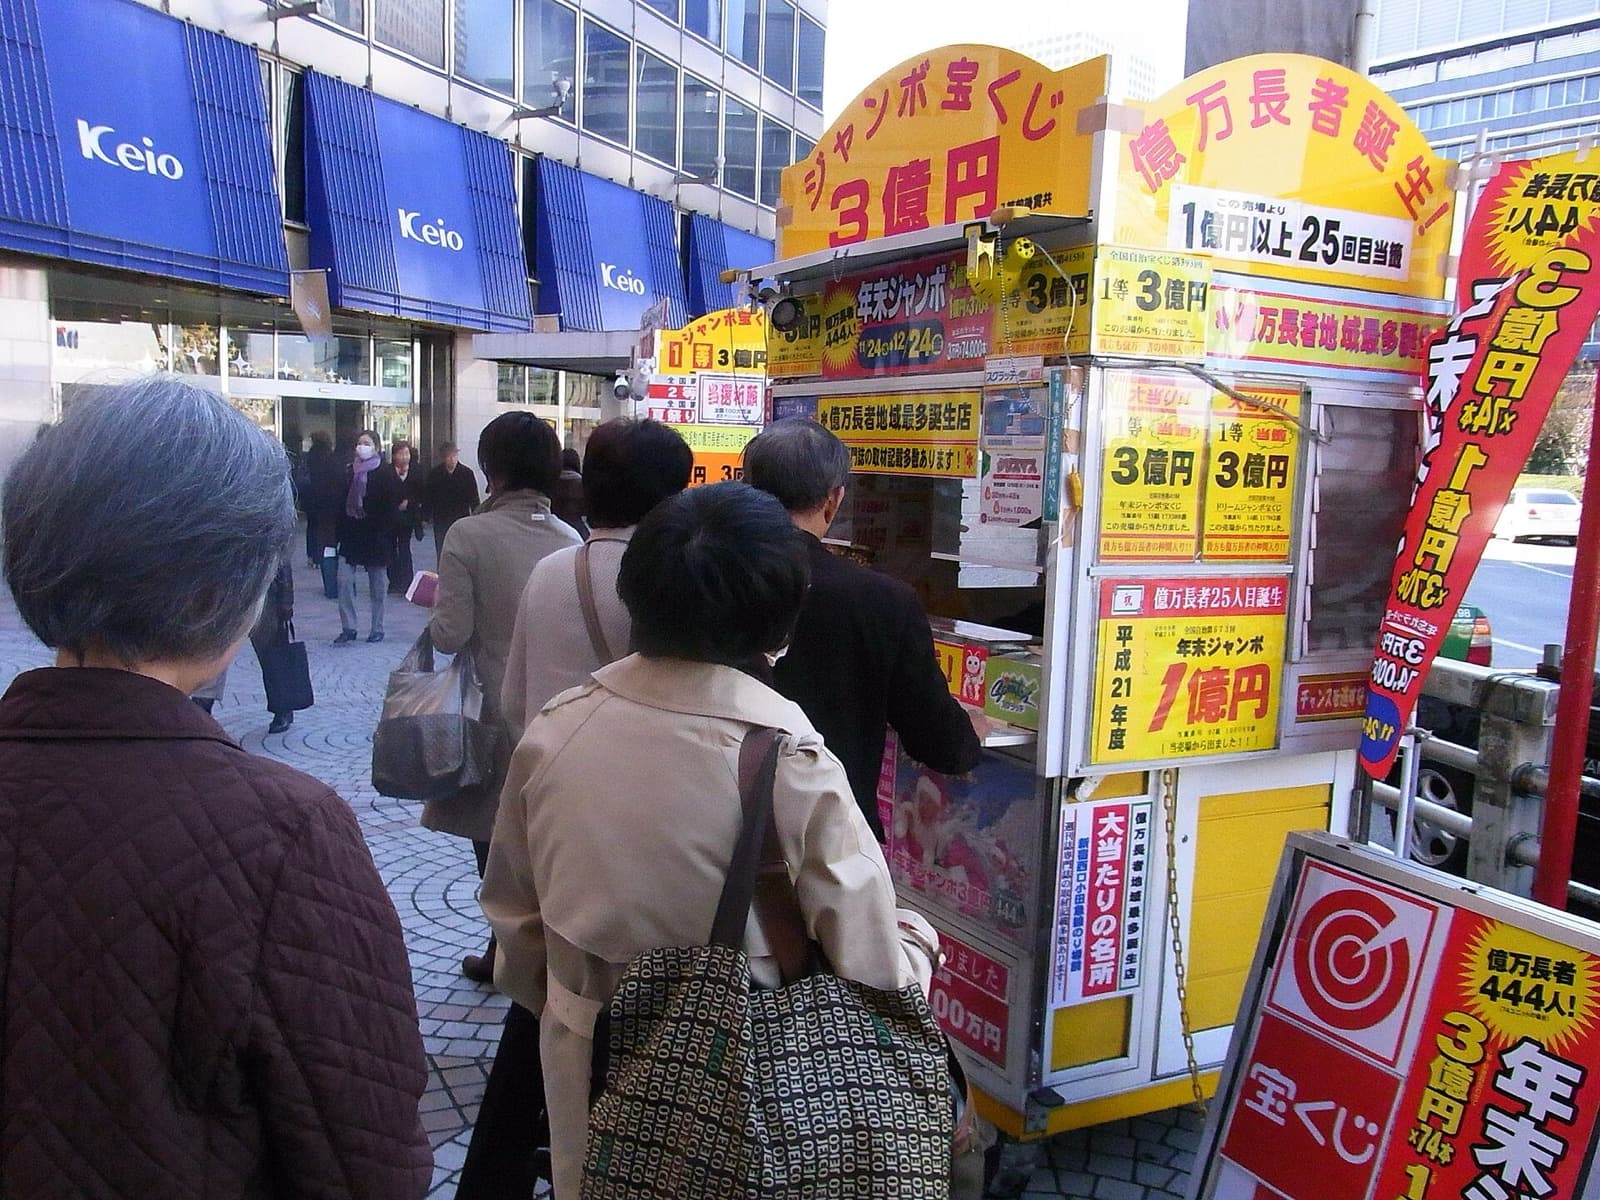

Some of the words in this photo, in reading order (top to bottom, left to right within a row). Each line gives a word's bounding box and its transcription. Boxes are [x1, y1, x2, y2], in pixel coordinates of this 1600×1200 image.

[77, 119, 184, 180] Keio
[804, 56, 1064, 212] ジャンボ宝くじ
[828, 135, 1001, 249] 3億円
[398, 208, 463, 251] Keio
[600, 262, 645, 295] Keio
[857, 264, 947, 324] 年末ジャンボ
[1101, 277, 1129, 301] 1等
[1136, 269, 1208, 312] 3億円
[1218, 422, 1244, 443] 1等
[1111, 446, 1195, 487] 3億円
[1215, 450, 1289, 490] 3億円
[1154, 587, 1283, 610] 億万長者25人目誕生
[1176, 634, 1264, 658] 年末ジャンボ
[1107, 625, 1133, 751] 平成21年度
[1147, 662, 1270, 734] 1億円
[1087, 811, 1124, 988] 大当たりの名所
[1487, 948, 1577, 986] 億万長者
[754, 1024, 769, 1057] JEICO
[768, 1021, 784, 1056] JEICO
[782, 1017, 798, 1053] JEICO
[795, 1014, 809, 1052] JEICO
[806, 1011, 823, 1046] JEICO
[819, 1008, 836, 1044] JEICO
[833, 1006, 850, 1043] JEICO
[846, 1008, 863, 1045] JEICO
[860, 1010, 877, 1045] JEICO
[760, 1061, 776, 1098] JEICO
[774, 1060, 790, 1097] JEICO
[788, 1056, 804, 1094] JEICO
[800, 1056, 817, 1092] JEICO
[813, 1051, 831, 1086] JEICO
[826, 1048, 844, 1086] JEICO
[841, 1046, 859, 1084] JEICO
[855, 1048, 872, 1085] JEICO
[868, 1049, 886, 1086] JEICO
[881, 1050, 898, 1087] JEICO
[895, 1050, 911, 1088] JEICO
[909, 1051, 924, 1088] JEICO
[921, 1053, 935, 1090] JEICO
[1418, 1011, 1489, 1135] 3億円
[766, 1103, 783, 1141] JEICO
[780, 1101, 797, 1140] JEICO
[794, 1098, 812, 1136] JEICO
[807, 1097, 826, 1134] JEICO
[821, 1091, 839, 1129] JEICO
[835, 1089, 852, 1128] JEICO
[849, 1087, 867, 1127] JEICO
[863, 1088, 881, 1128] JEICO
[877, 1089, 894, 1128] JEICO
[890, 1090, 906, 1130] JEICO
[902, 1092, 918, 1130] JEICO
[914, 1093, 929, 1131] JEICO
[928, 1094, 940, 1132] JEICO
[1245, 1061, 1380, 1165] 宝くじ
[773, 1146, 787, 1185] JEICO
[787, 1144, 801, 1183] JEICO
[802, 1141, 816, 1180] JEICO
[816, 1139, 828, 1178] JEICO
[829, 1134, 840, 1174] JEICO
[842, 1133, 854, 1172] JEICO
[856, 1130, 869, 1171] JEICO
[871, 1131, 885, 1172] JEICO
[884, 1132, 898, 1172] JEICO
[897, 1133, 911, 1173] JEICO
[908, 1133, 921, 1174] JEICO
[920, 1135, 932, 1175] JEICO
[931, 1135, 942, 1175] JEICO
